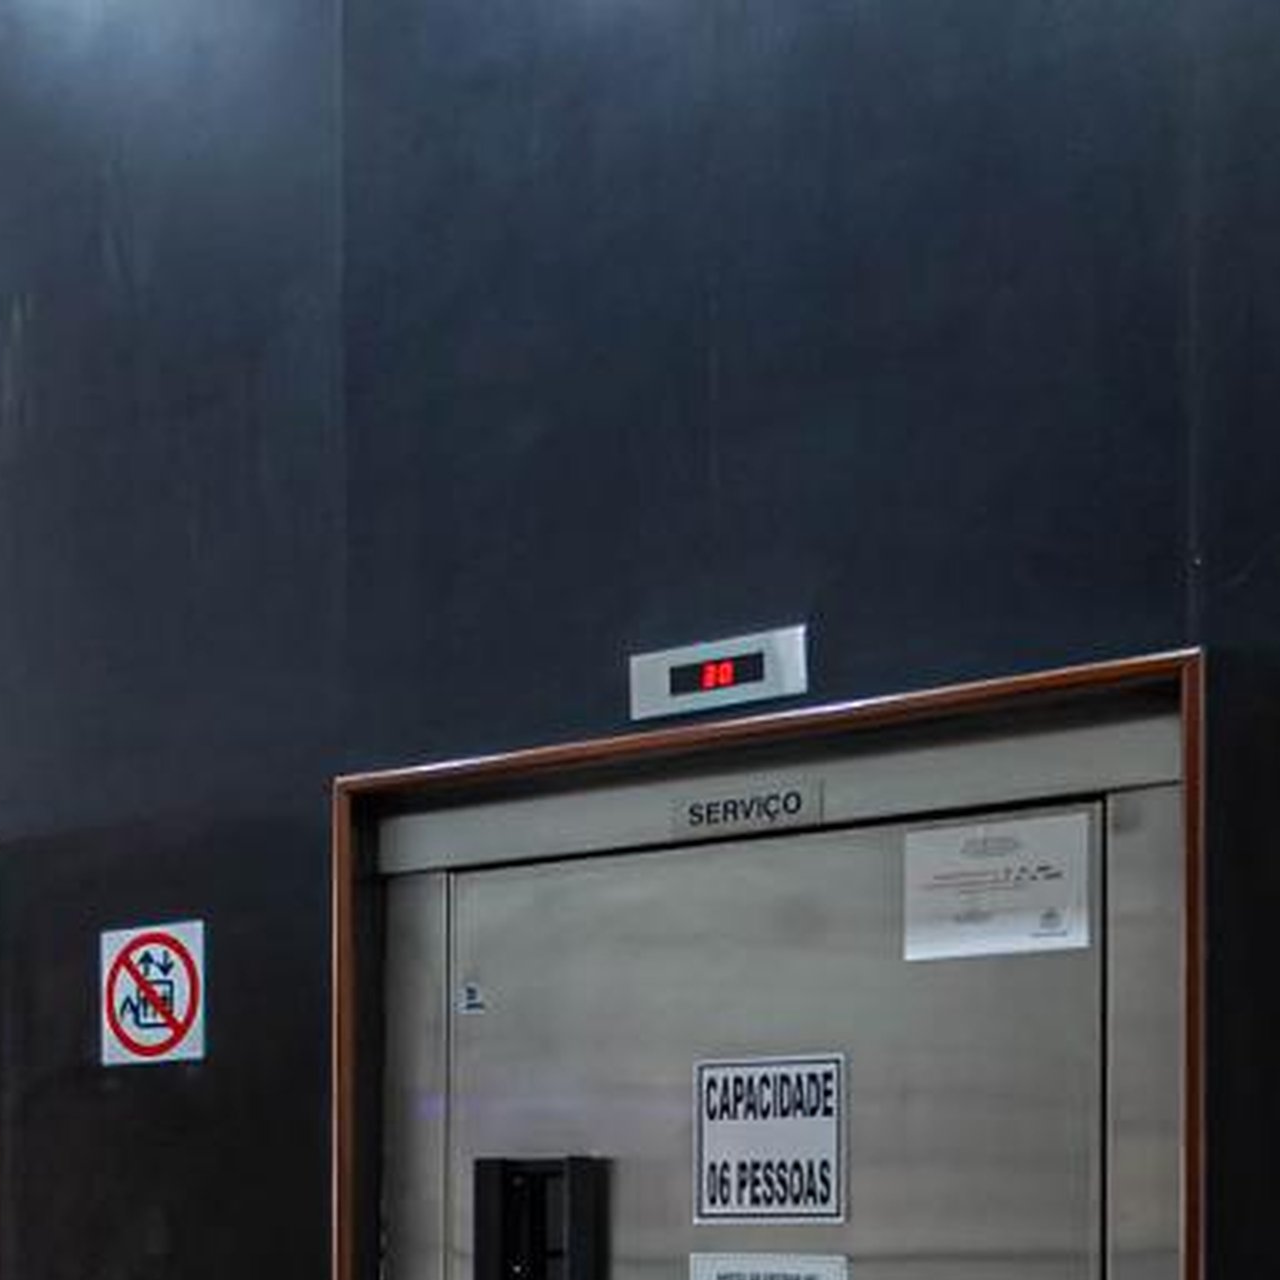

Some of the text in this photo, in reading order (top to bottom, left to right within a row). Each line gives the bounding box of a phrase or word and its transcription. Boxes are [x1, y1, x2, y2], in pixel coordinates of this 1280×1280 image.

[688, 790, 802, 827] SERVIÇO
[705, 1071, 835, 1121] CAPACIDADE
[707, 1159, 833, 1206] 06 PESSOAS
